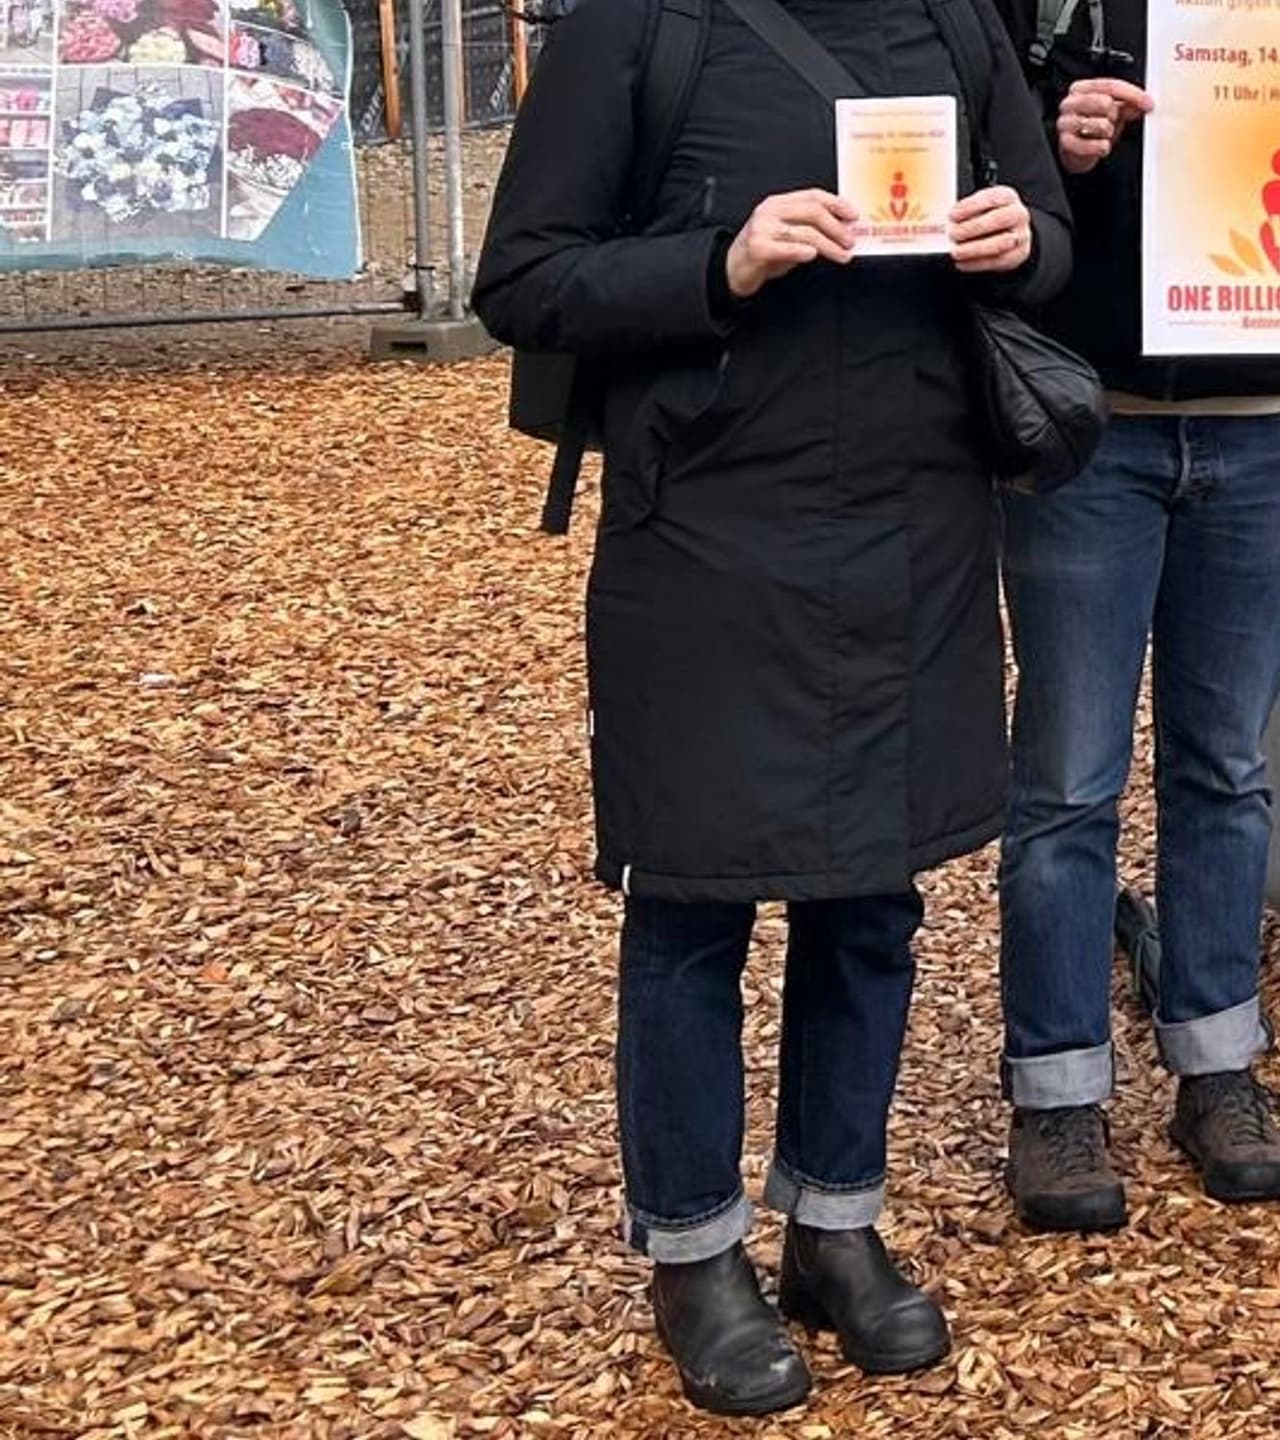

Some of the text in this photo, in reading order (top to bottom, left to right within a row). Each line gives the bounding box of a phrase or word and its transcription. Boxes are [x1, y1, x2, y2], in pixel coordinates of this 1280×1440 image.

[1174, 44, 1252, 67] Samstag,
[1213, 85, 1227, 101] 11
[1233, 86, 1259, 101] Uhr
[1168, 285, 1211, 311] ONE
